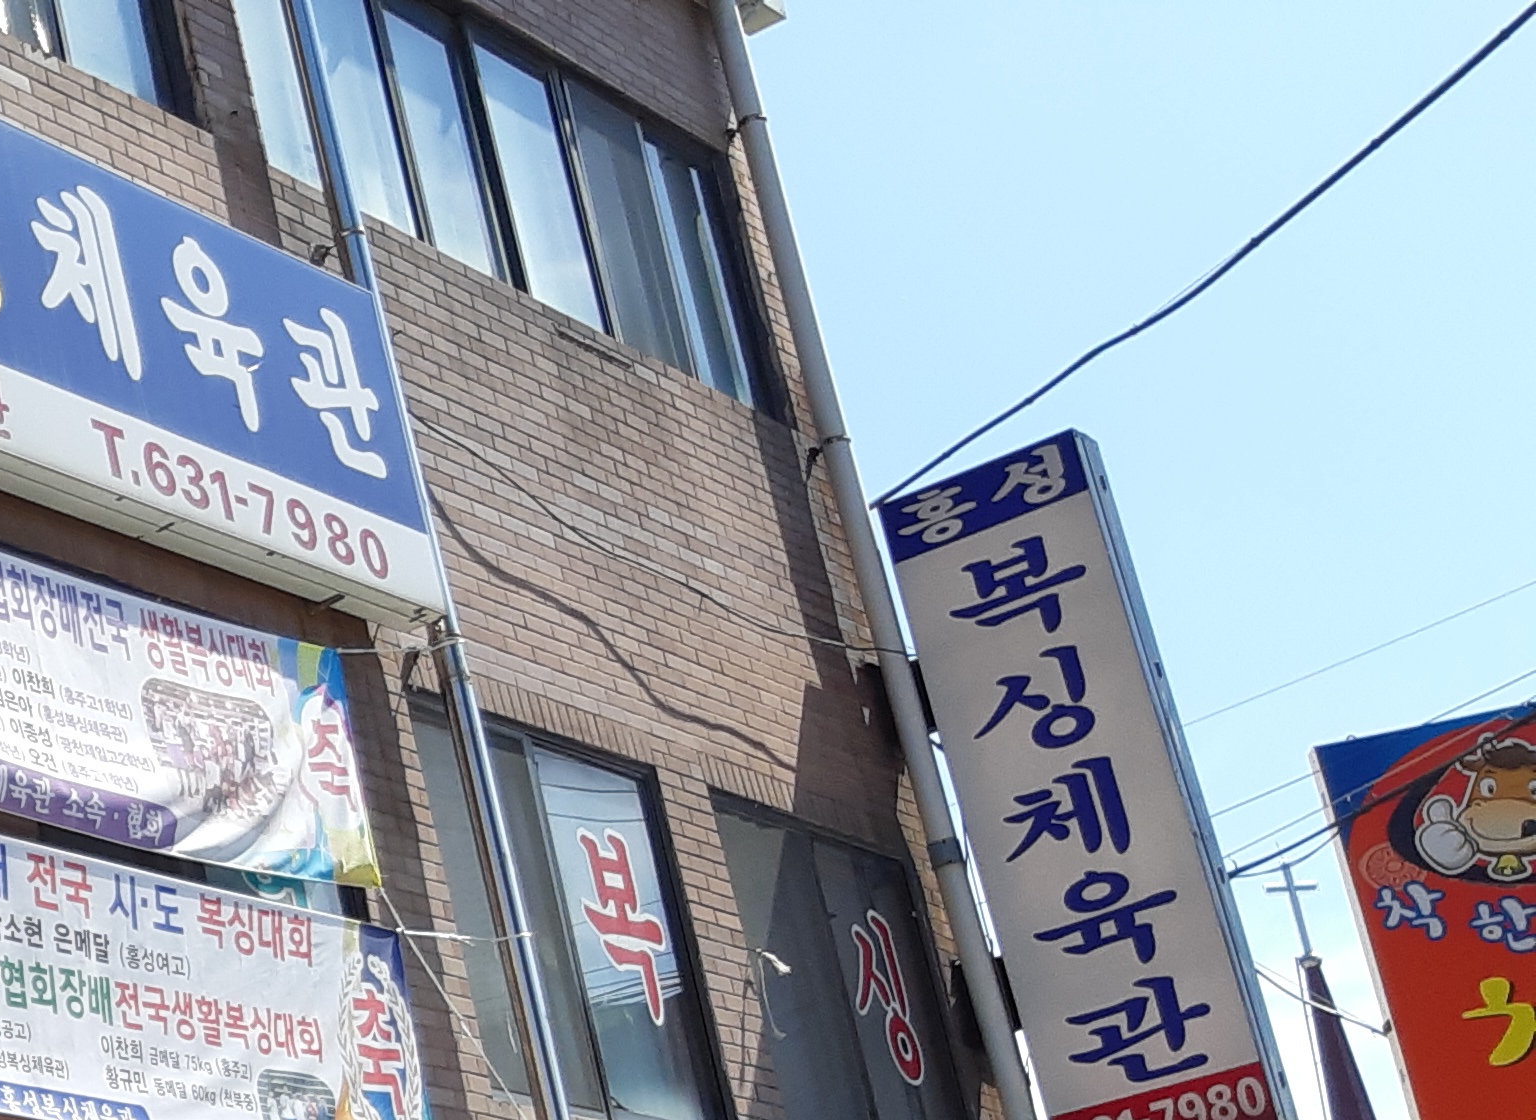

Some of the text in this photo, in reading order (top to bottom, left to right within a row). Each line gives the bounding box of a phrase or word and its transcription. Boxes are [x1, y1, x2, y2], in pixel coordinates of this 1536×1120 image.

[91, 419, 391, 581] T.631-7980
[896, 443, 1068, 545] 홍성
[949, 534, 1211, 1083] 복싱체육관
[26, 851, 93, 919] 전국
[195, 892, 315, 968] 복싱대회
[53, 922, 111, 965] 은메달
[118, 942, 192, 981] (홍성여고)
[577, 826, 667, 1026] 복
[100, 1033, 145, 1064] 이찬희
[184, 1053, 214, 1076] 75kg
[351, 987, 406, 1116] 축
[850, 908, 925, 1087] 싱
[104, 1064, 150, 1095] 황규민
[190, 1082, 218, 1107] 60kg
